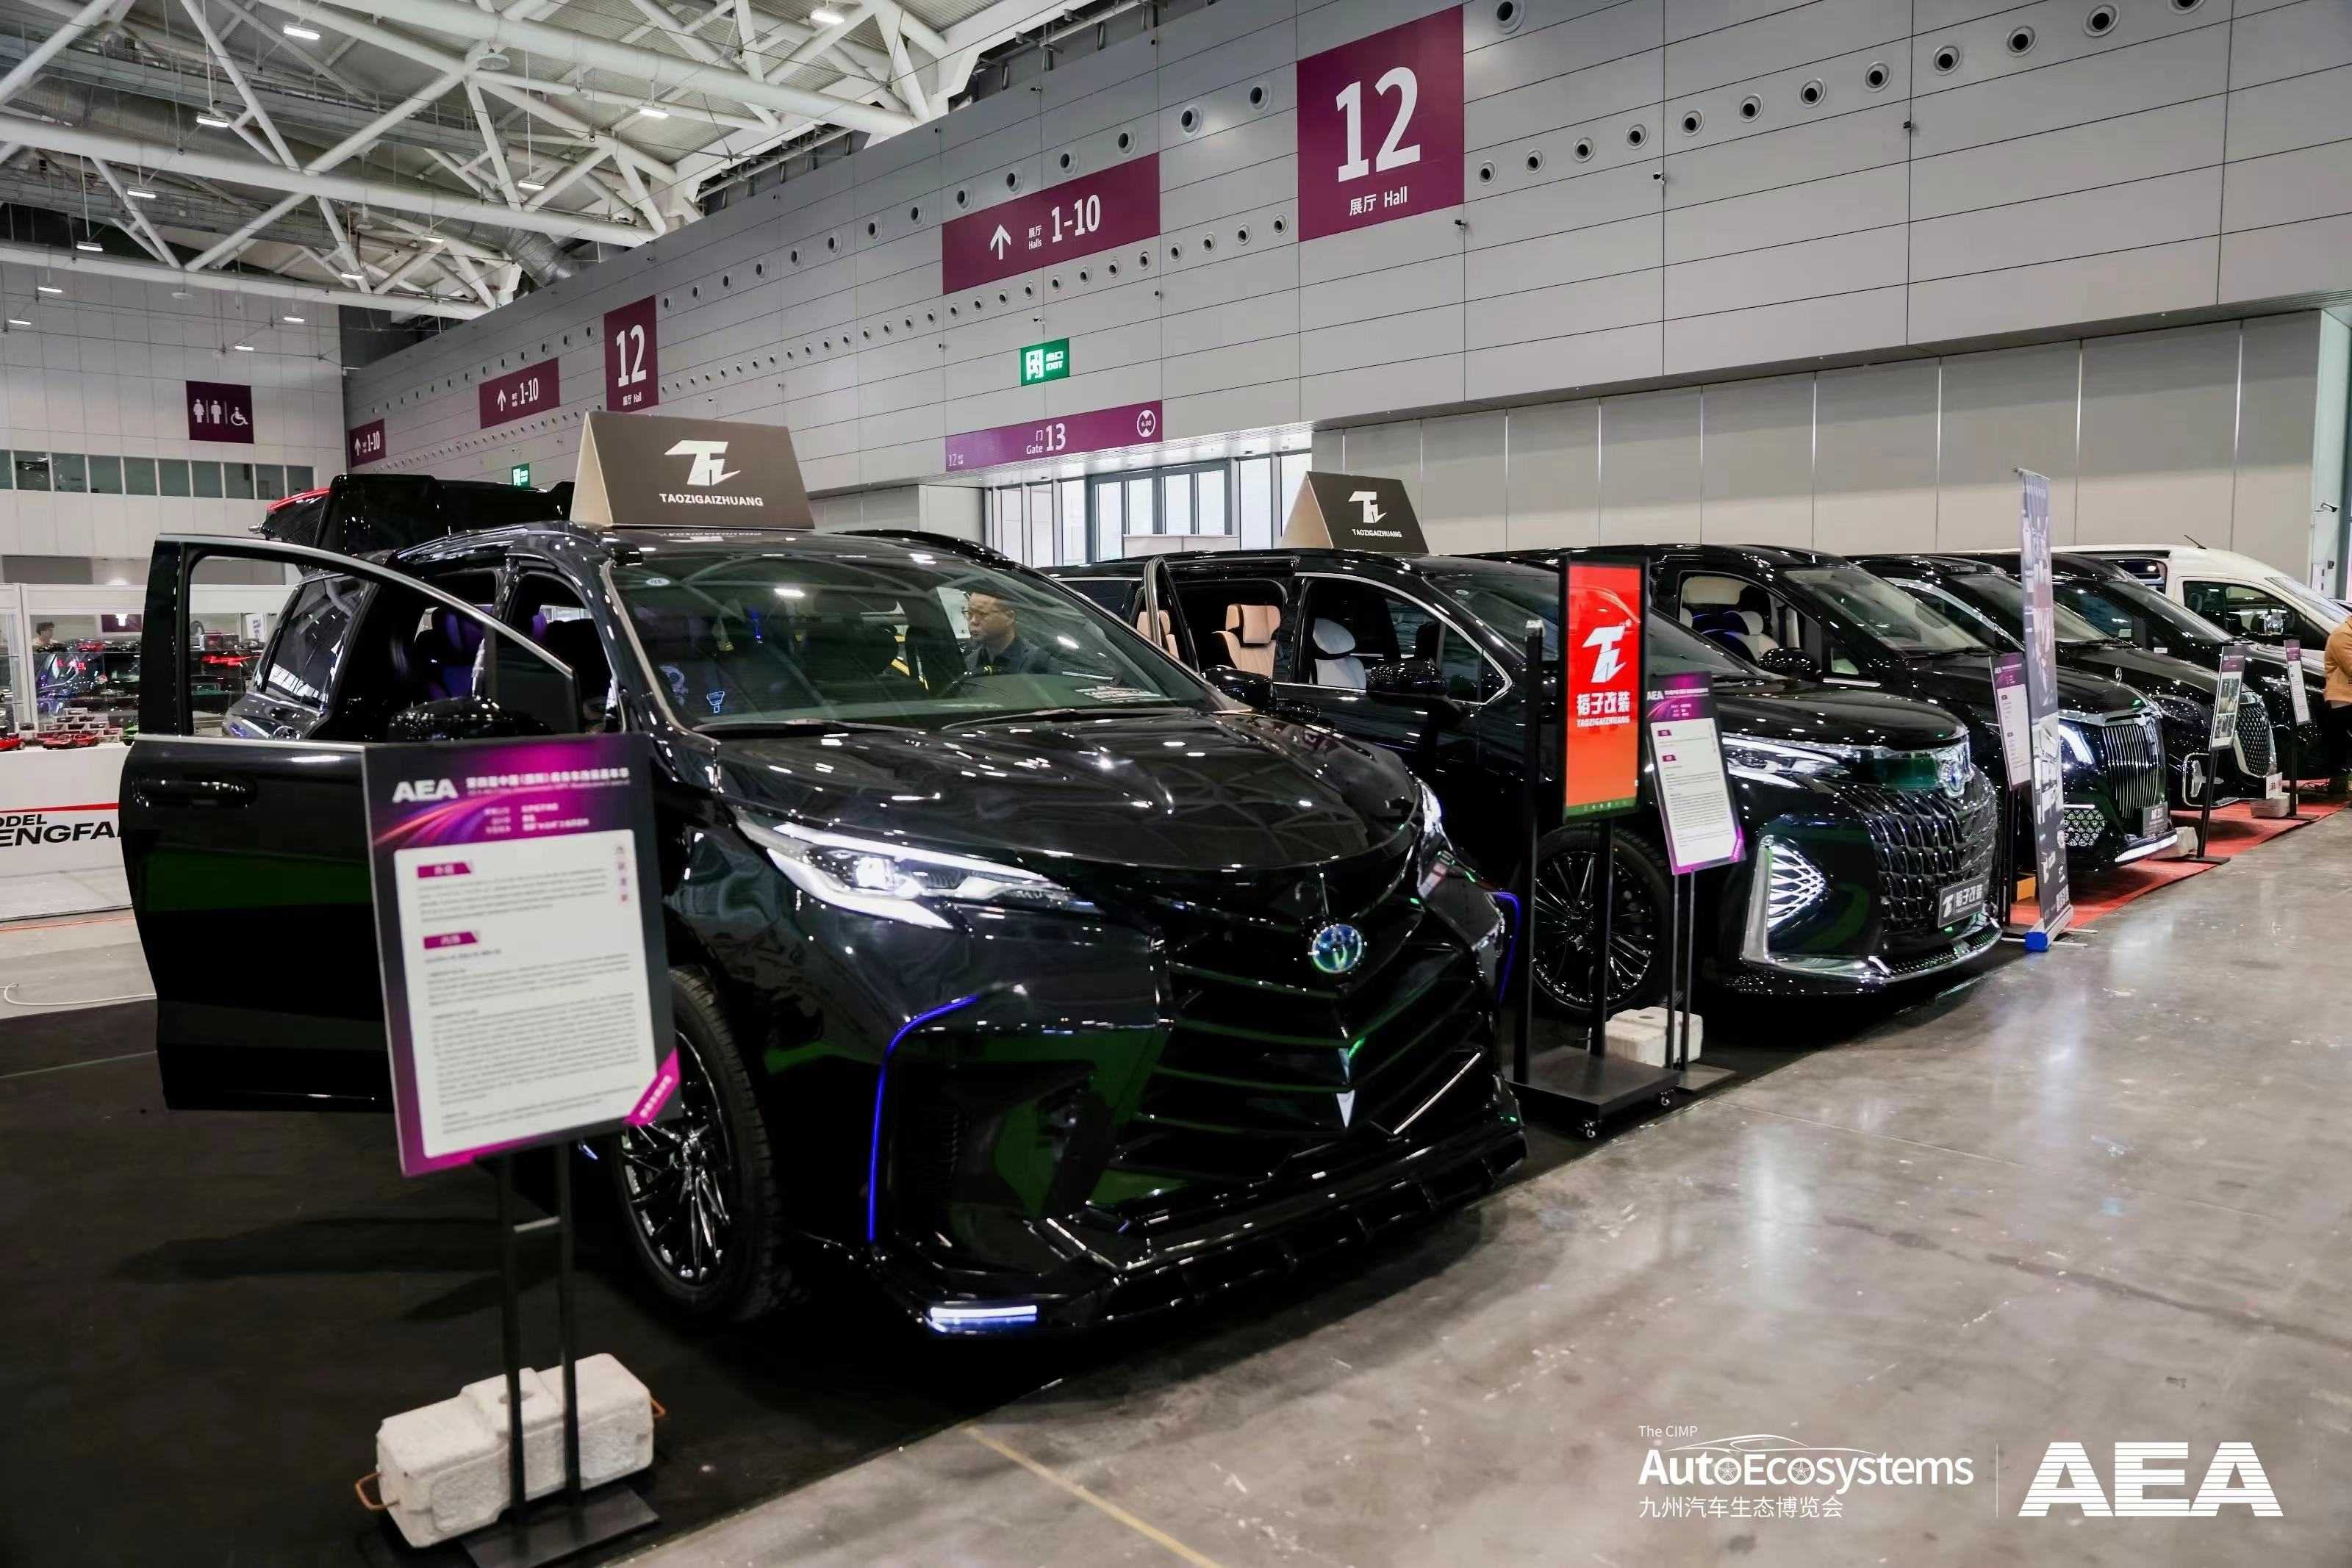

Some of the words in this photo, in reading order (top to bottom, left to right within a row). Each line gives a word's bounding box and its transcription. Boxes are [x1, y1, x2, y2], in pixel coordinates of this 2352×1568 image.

[1335, 66, 1421, 183] 12
[1349, 193, 1377, 216] 展厅
[1384, 185, 1408, 207] Hall
[1051, 194, 1100, 243] 1-10
[1028, 225, 1042, 239] 展厅
[1028, 238, 1042, 250] Halls
[616, 324, 647, 387] 12
[520, 377, 539, 405] 1-10
[633, 392, 642, 403] Hall
[367, 431, 381, 452] 1-10
[1036, 430, 1043, 442] 门
[1045, 422, 1066, 451] 13
[1026, 443, 1043, 455] Gate
[948, 453, 957, 467] 12
[659, 493, 764, 507] TAOZIGAIZHUANG
[1351, 528, 1402, 538] TAOZIGAIZHUANG
[1646, 690, 1665, 701] AEA
[392, 777, 459, 804] AEA
[0, 821, 121, 847] ENGFA
